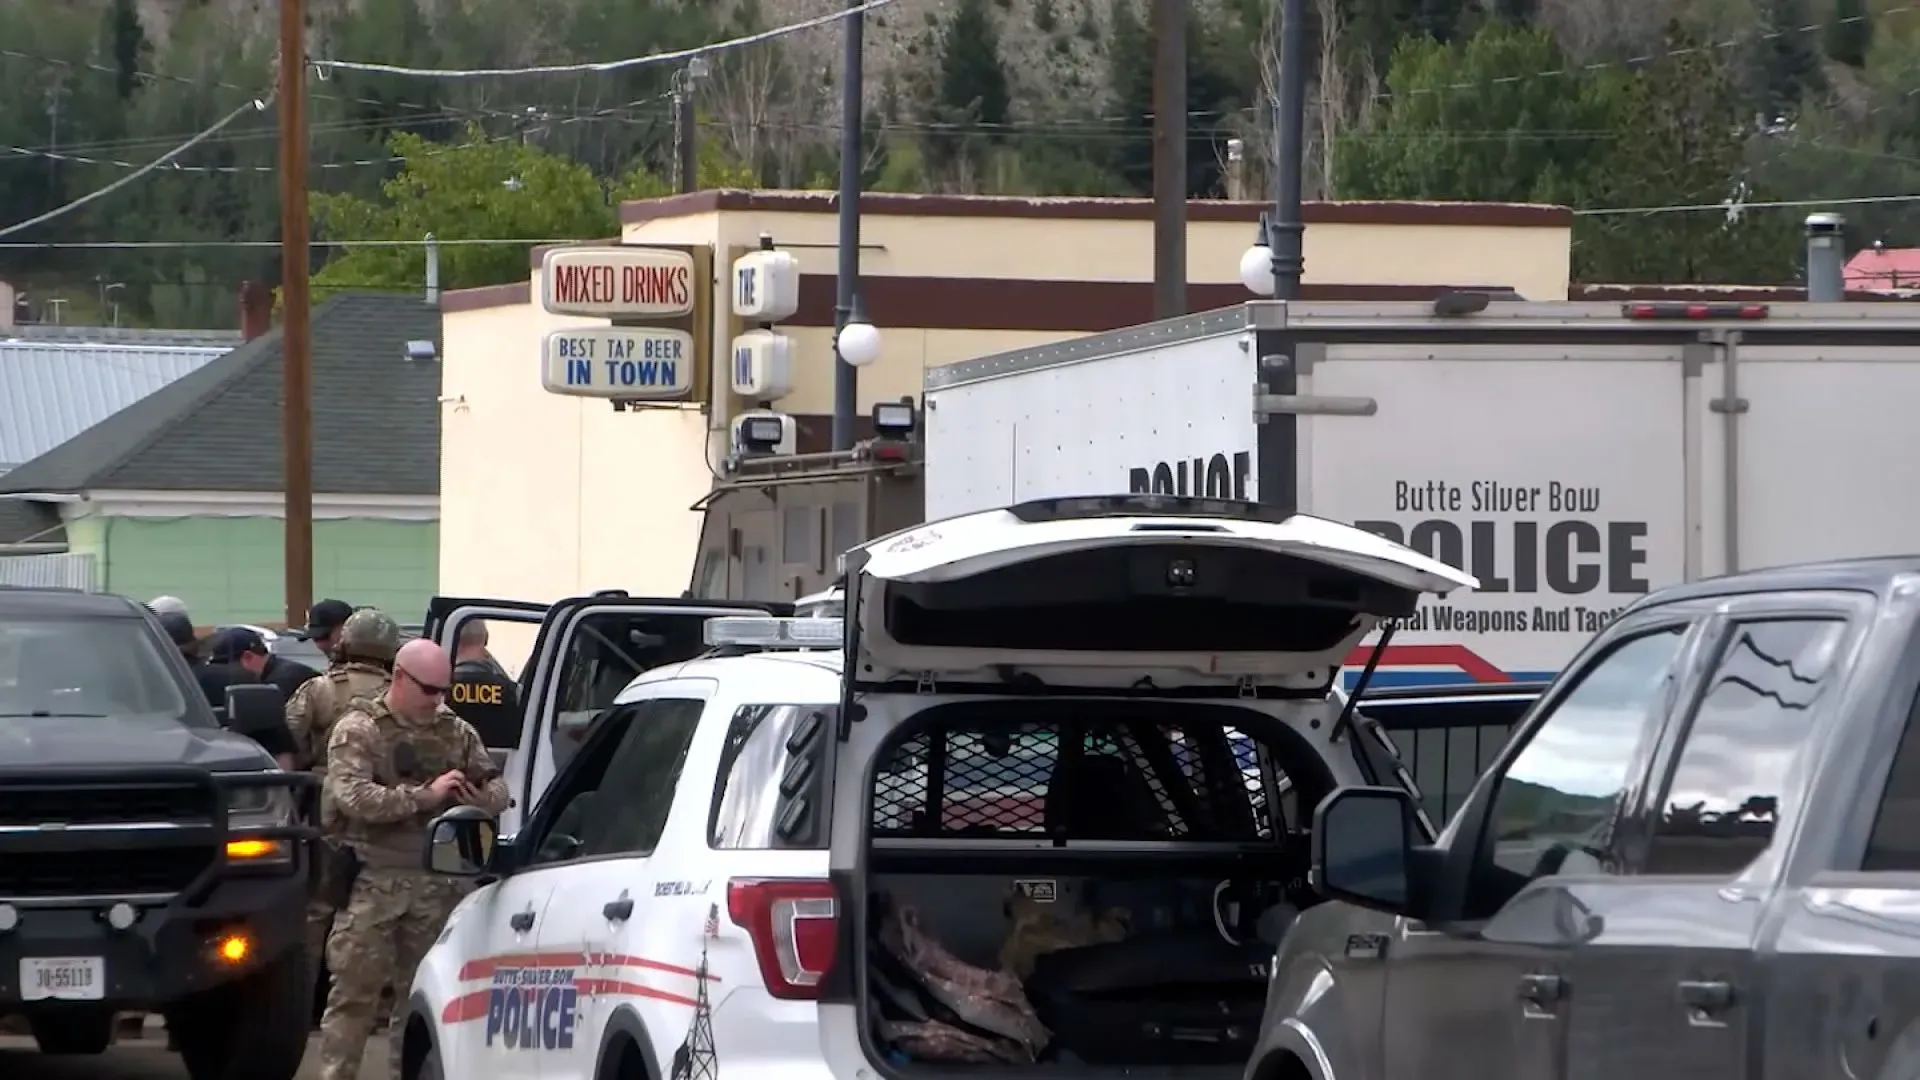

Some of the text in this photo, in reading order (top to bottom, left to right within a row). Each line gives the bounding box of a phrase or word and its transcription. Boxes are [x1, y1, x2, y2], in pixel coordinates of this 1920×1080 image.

[555, 265, 689, 305] MIXED DRINKS
[739, 267, 756, 307] THE
[559, 338, 682, 359] BEST TAP BEER
[567, 359, 676, 386] IN TOWN
[735, 347, 754, 386] OWL
[1396, 480, 1600, 512] Butte Silver Bow
[1354, 519, 1649, 594] OLICE
[1433, 606, 1528, 634] Weapons
[1532, 606, 1570, 633] And
[452, 683, 502, 704] OLICE
[486, 987, 577, 1050] POLICE
